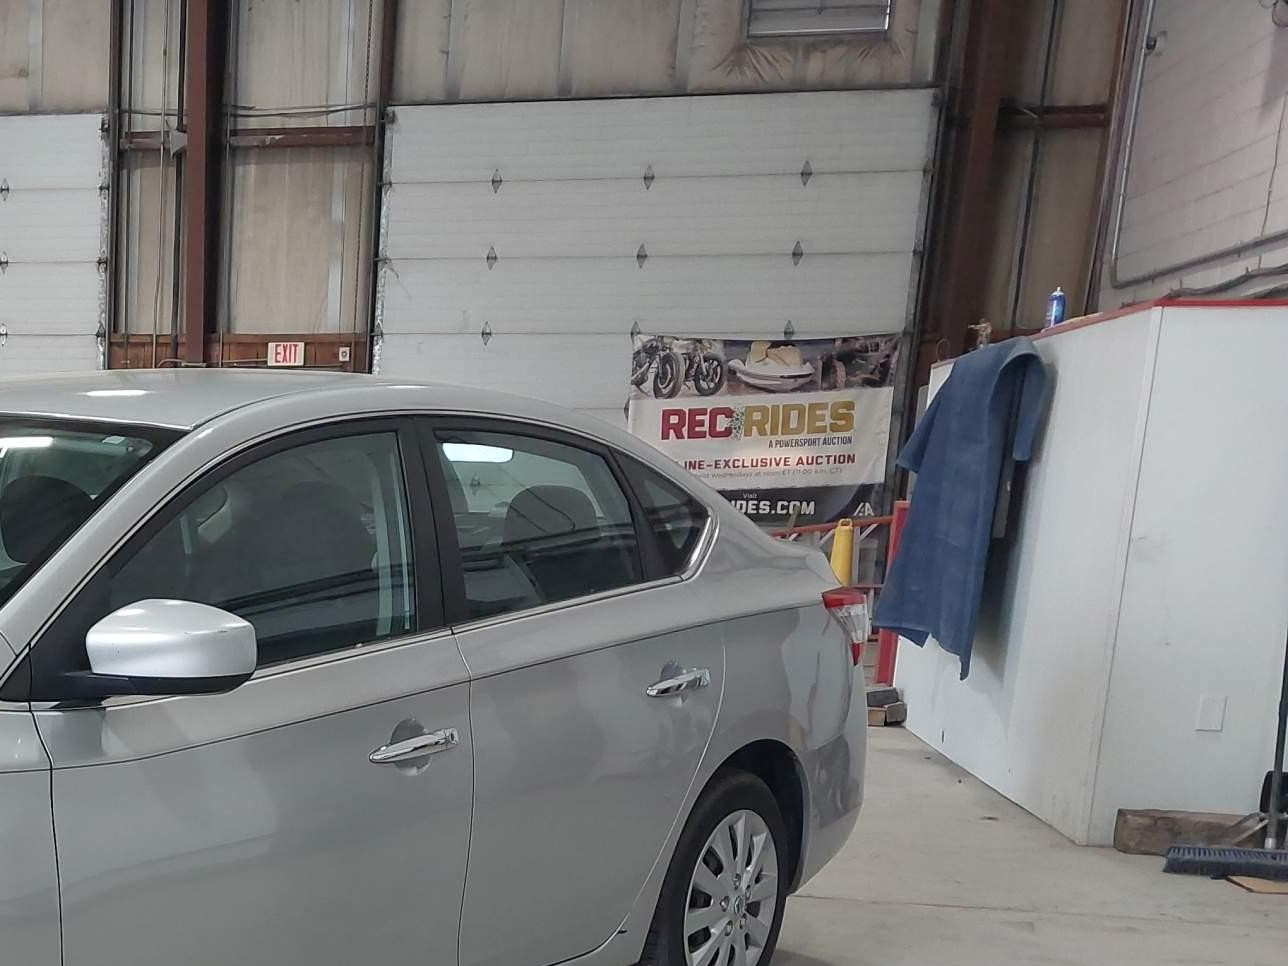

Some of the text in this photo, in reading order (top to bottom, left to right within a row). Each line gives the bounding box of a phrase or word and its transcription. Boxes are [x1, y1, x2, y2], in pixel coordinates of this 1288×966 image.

[274, 344, 299, 363] EXIT
[661, 400, 856, 440] REC RIDES
[768, 436, 852, 448] A POWERSPORT AUCTION
[684, 453, 856, 470] INE-EXCLUSIVE AUCTION
